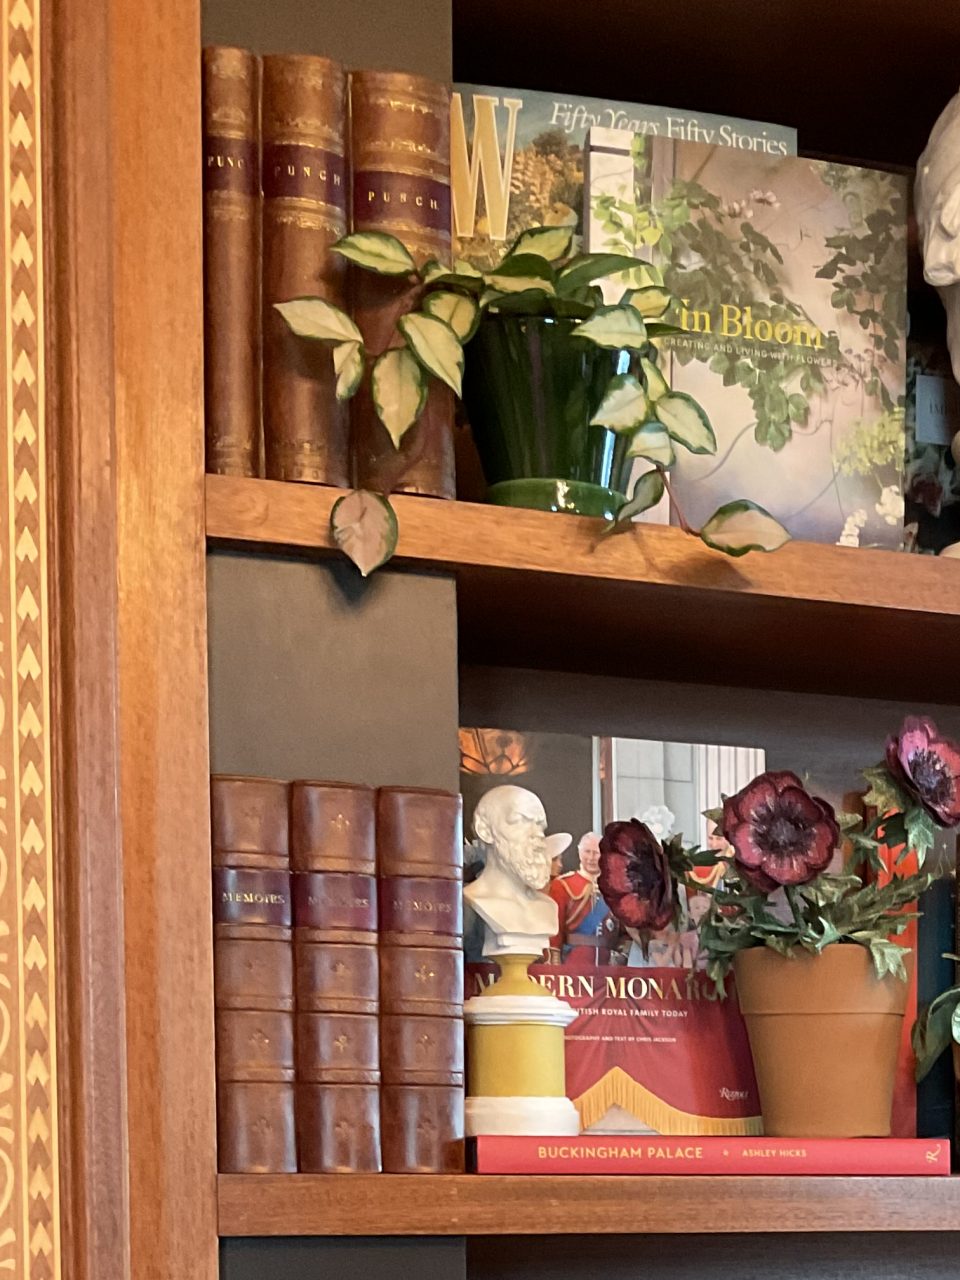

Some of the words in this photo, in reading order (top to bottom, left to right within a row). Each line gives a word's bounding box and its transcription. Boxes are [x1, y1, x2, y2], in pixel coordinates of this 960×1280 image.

[550, 102, 600, 134] Fifty
[603, 108, 661, 136] Years
[666, 116, 714, 144] Fifty
[718, 124, 788, 156] Stories
[720, 303, 826, 350] Bloom
[664, 336, 710, 351] CREATING
[714, 344, 733, 354] AND
[736, 346, 768, 359] LIVING
[601, 1008, 628, 1016] ROYAL
[630, 1008, 659, 1017] FAMILY
[662, 1010, 688, 1018] TODAY
[538, 1146, 642, 1160] BUCKINGHAM
[648, 1146, 704, 1160] PALACE
[742, 1148, 777, 1158] ASHLEY
[779, 1149, 807, 1158] HICKS
